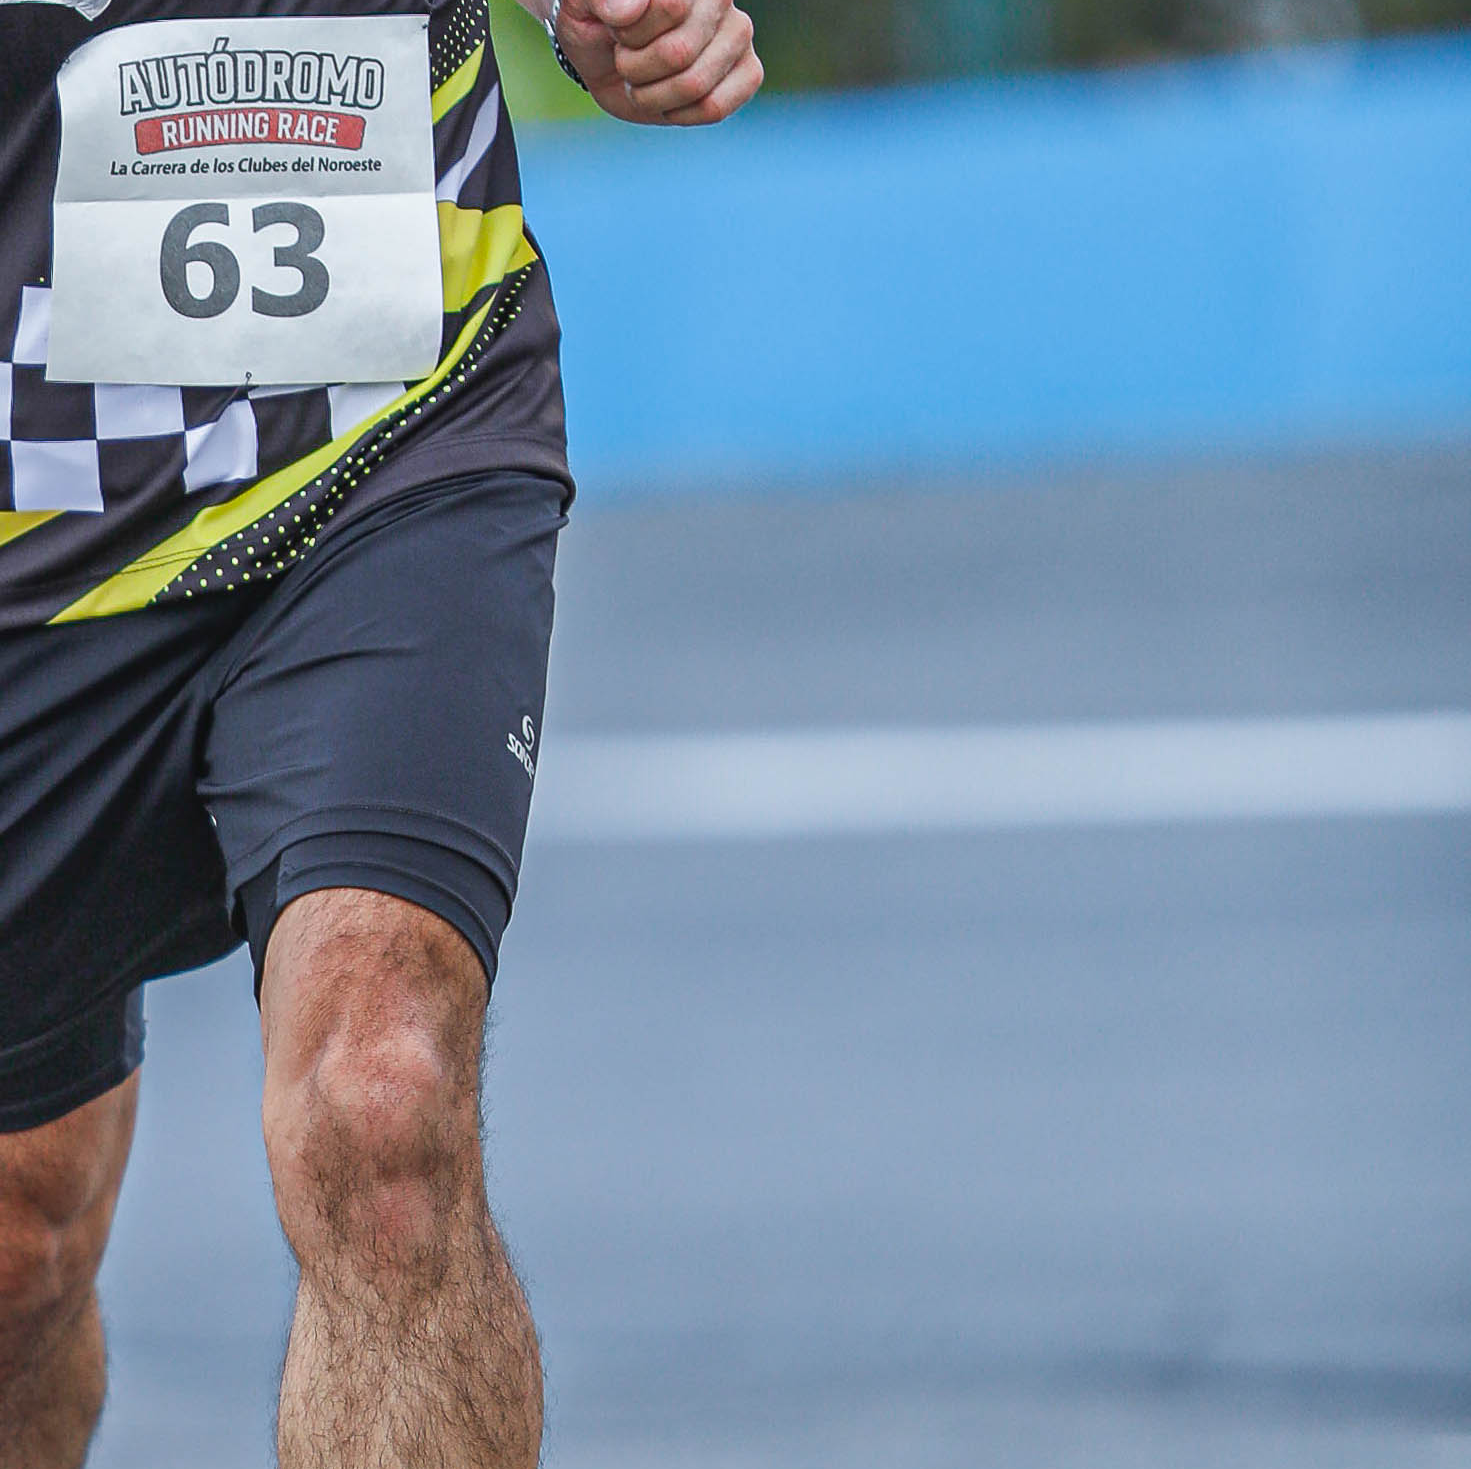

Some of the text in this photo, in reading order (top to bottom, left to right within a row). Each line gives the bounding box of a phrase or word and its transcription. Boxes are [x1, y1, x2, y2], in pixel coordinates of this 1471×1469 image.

[118, 37, 385, 115] AUTÓDROMO
[161, 111, 340, 148] RUNNING RACE
[110, 156, 382, 176] La Carrera de los Clubes del Noroeste
[159, 202, 331, 319] 63
